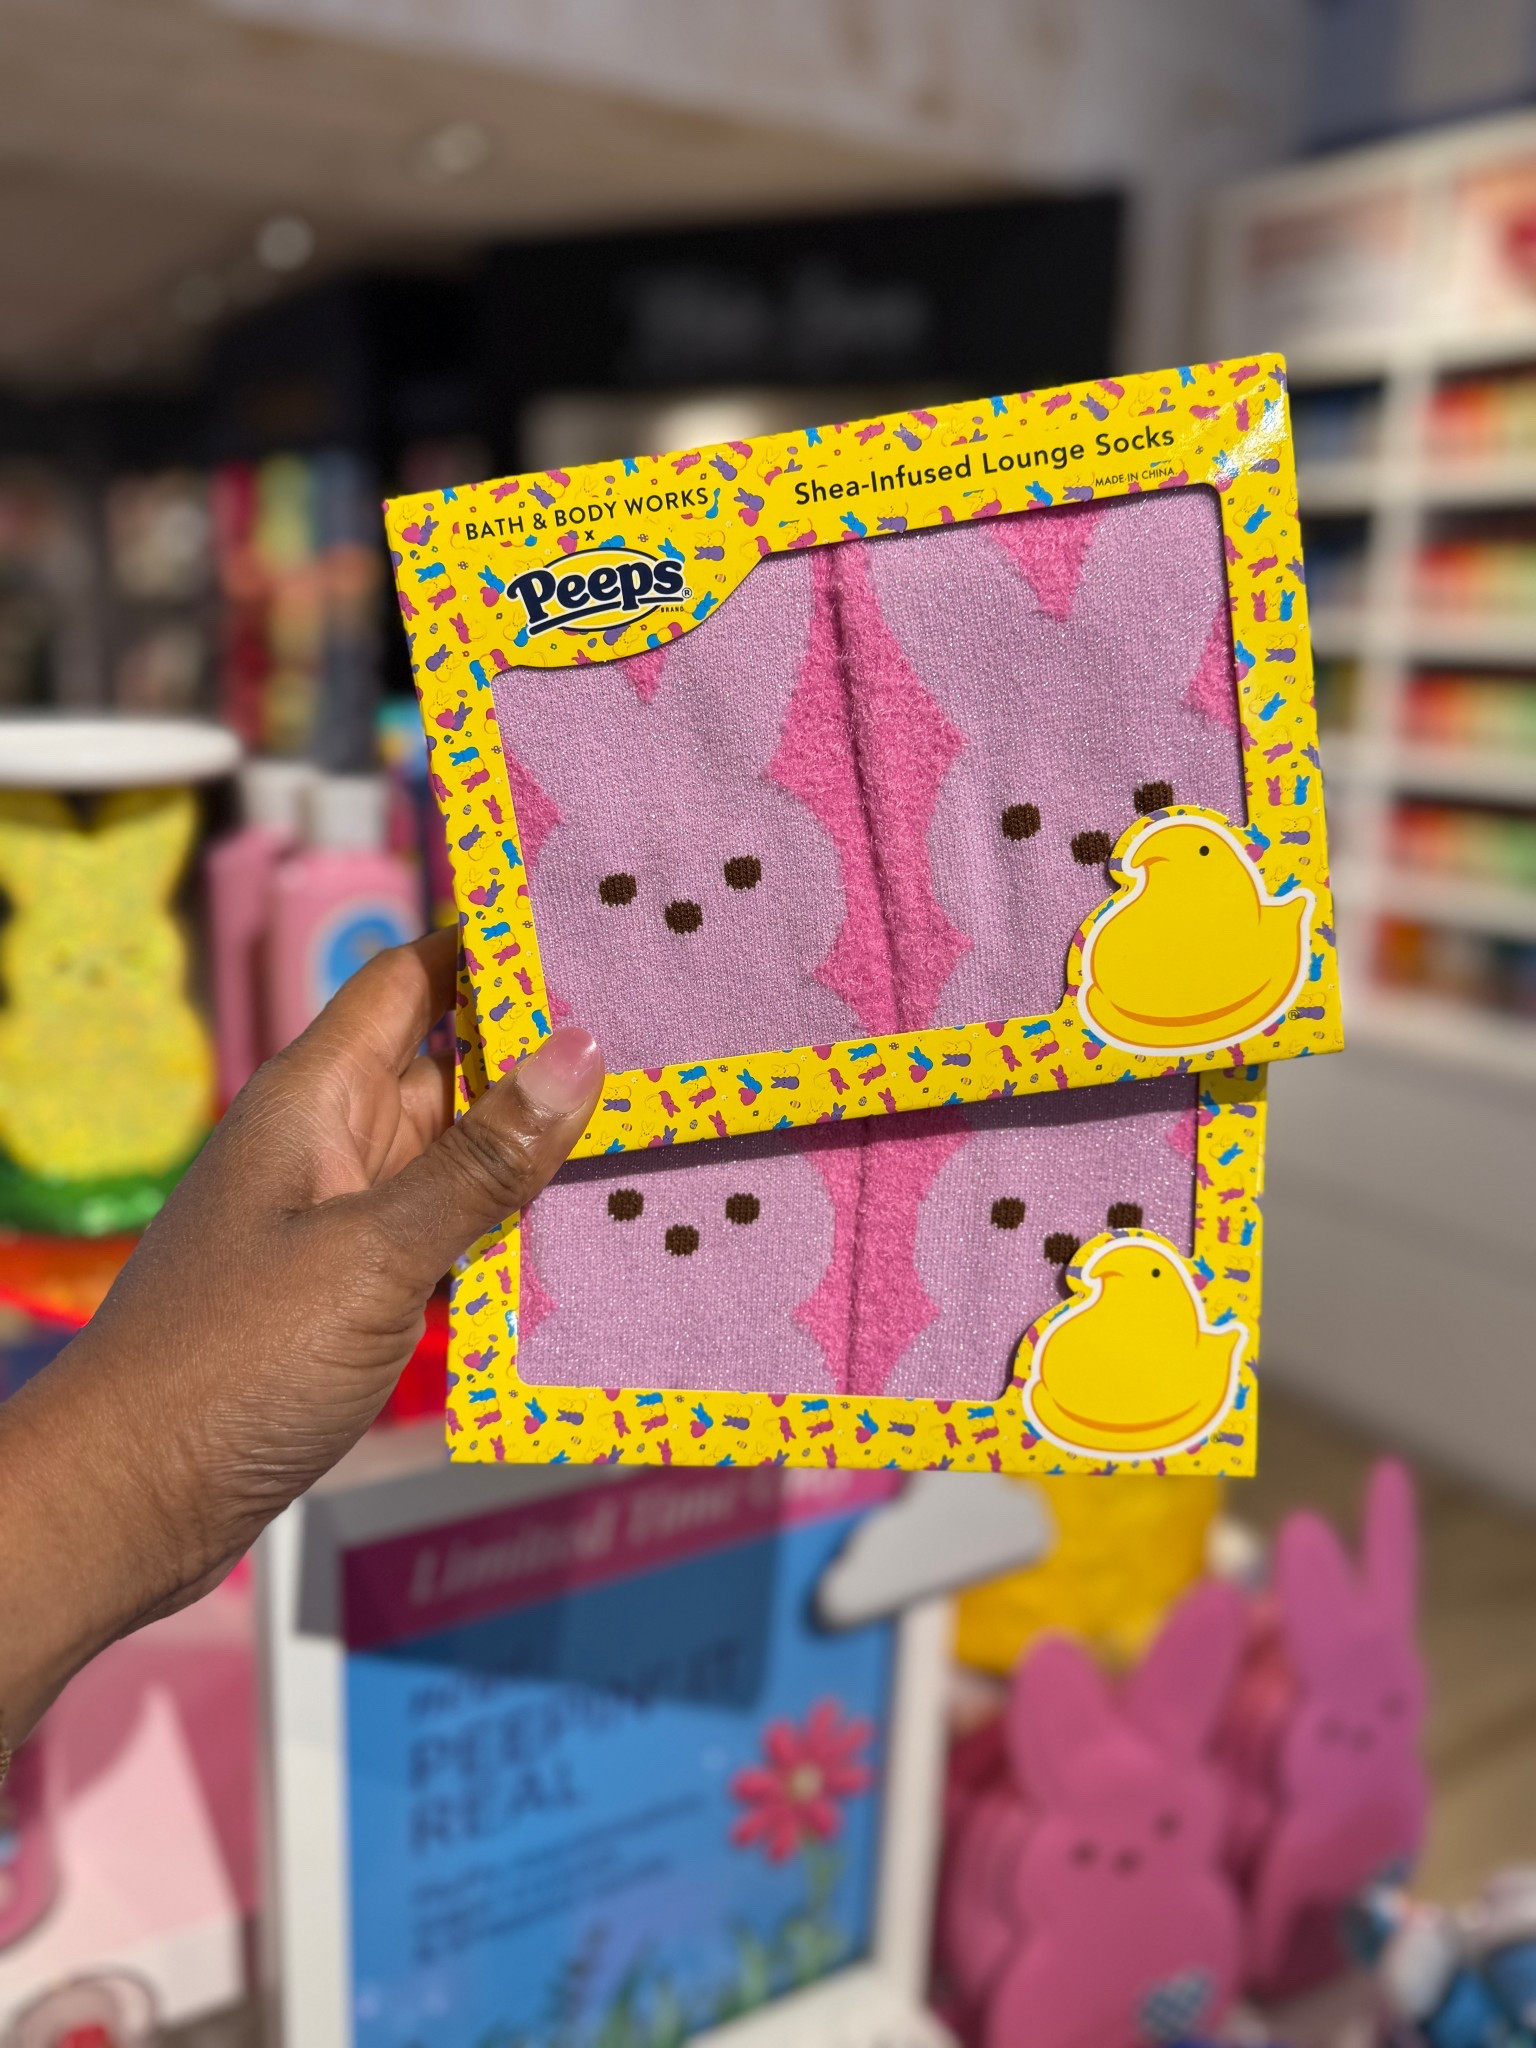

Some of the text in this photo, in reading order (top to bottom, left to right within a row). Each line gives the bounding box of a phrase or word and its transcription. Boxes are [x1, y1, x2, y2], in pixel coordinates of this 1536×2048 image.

[795, 425, 1175, 506] Shea-Infused Lounge Socks
[1095, 467, 1175, 487] MADE IN CHINA
[465, 487, 709, 541] BATH & BODY WORKS
[506, 560, 685, 625] Peeps
